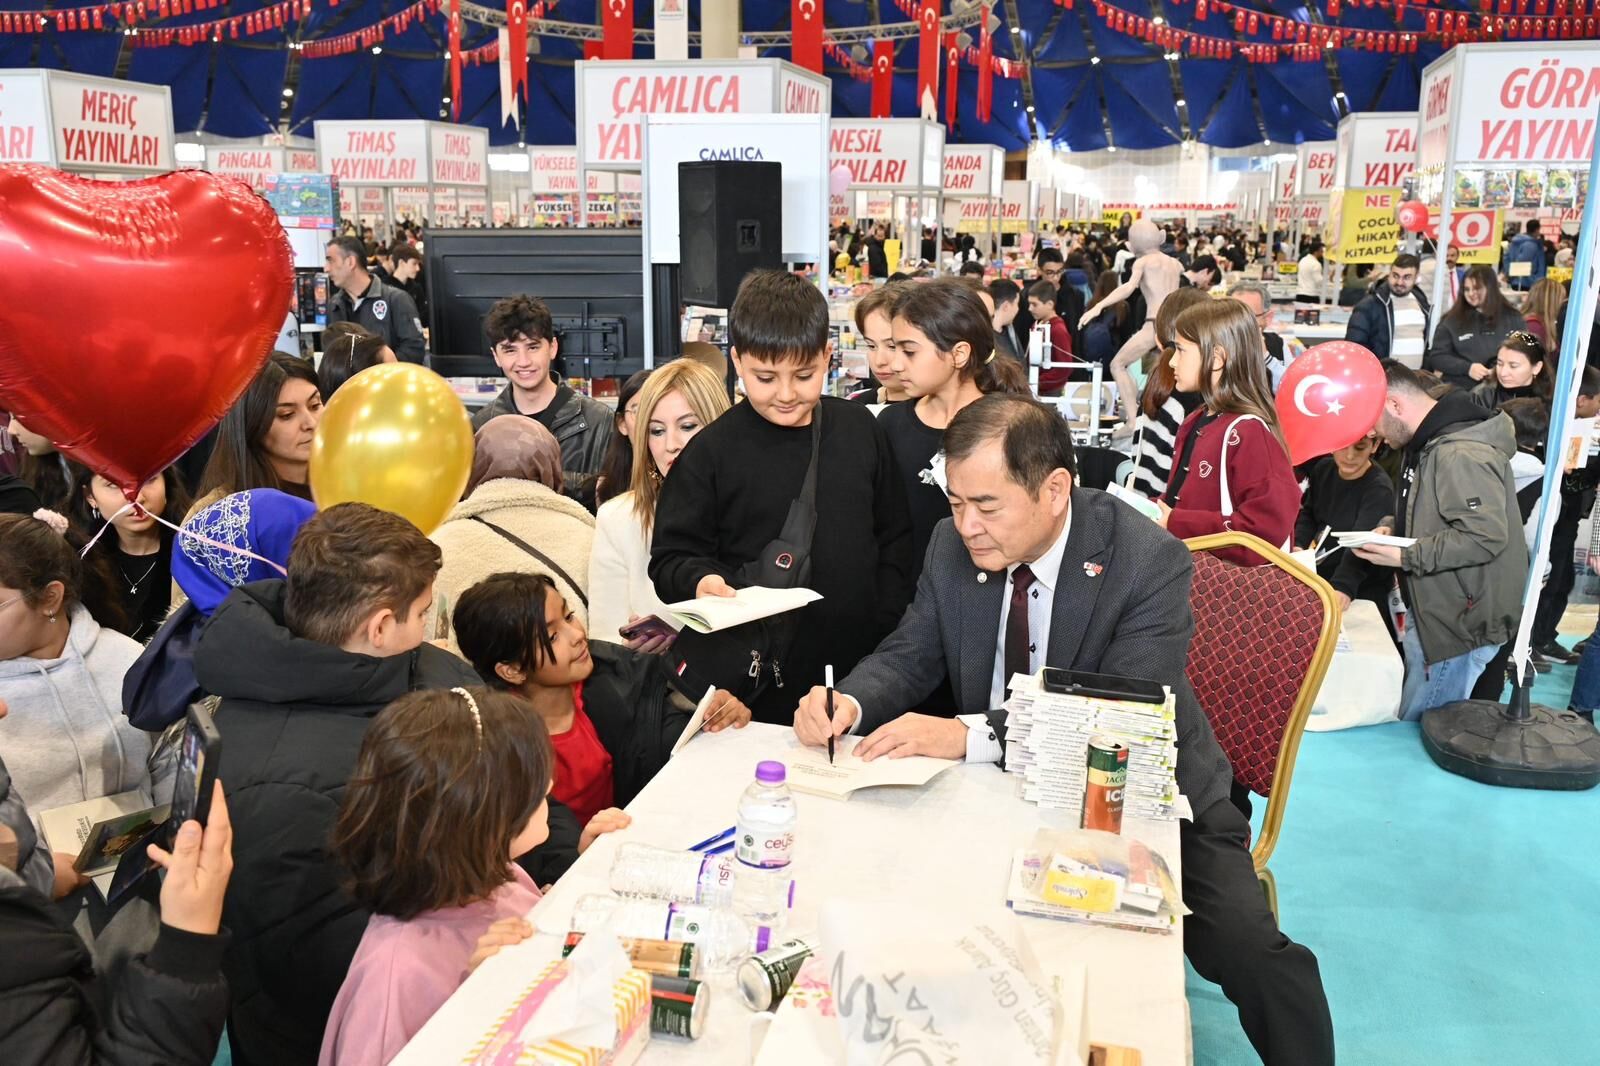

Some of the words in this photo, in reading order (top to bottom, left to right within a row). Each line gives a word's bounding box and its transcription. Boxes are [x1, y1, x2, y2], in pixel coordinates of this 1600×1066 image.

[612, 75, 740, 118] ÇAMLICA
[63, 128, 159, 165] YAYINLARI
[1478, 119, 1595, 159] YAYIN
[331, 158, 416, 180] YAYINLARI
[435, 159, 481, 182] YAYINLARI
[588, 203, 612, 211] ZEKA
[1365, 195, 1391, 207] NE
